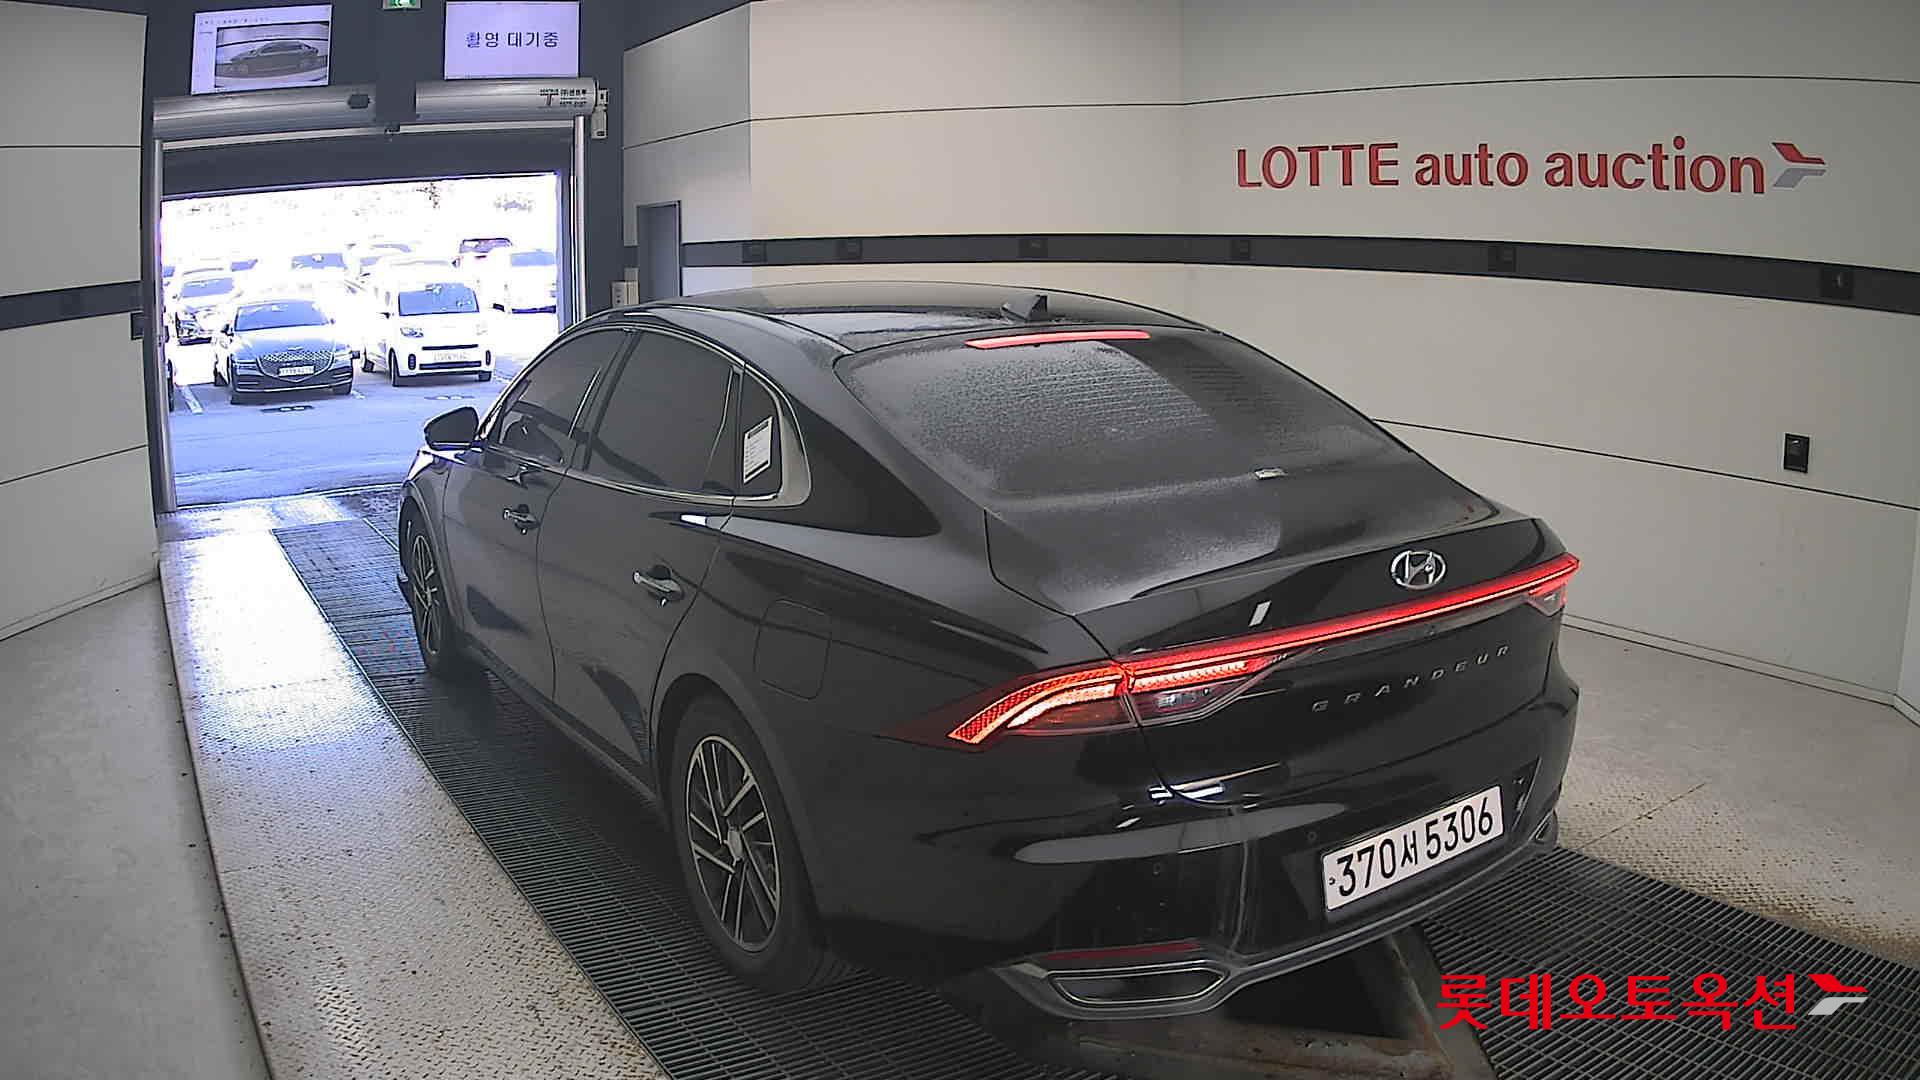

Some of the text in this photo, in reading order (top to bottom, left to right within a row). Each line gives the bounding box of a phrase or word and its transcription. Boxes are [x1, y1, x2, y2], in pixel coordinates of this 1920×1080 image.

[507, 32, 559, 48] 대기중
[1237, 135, 1766, 194] LOTTE auto auction
[1311, 645, 1510, 713] GRANDEUR
